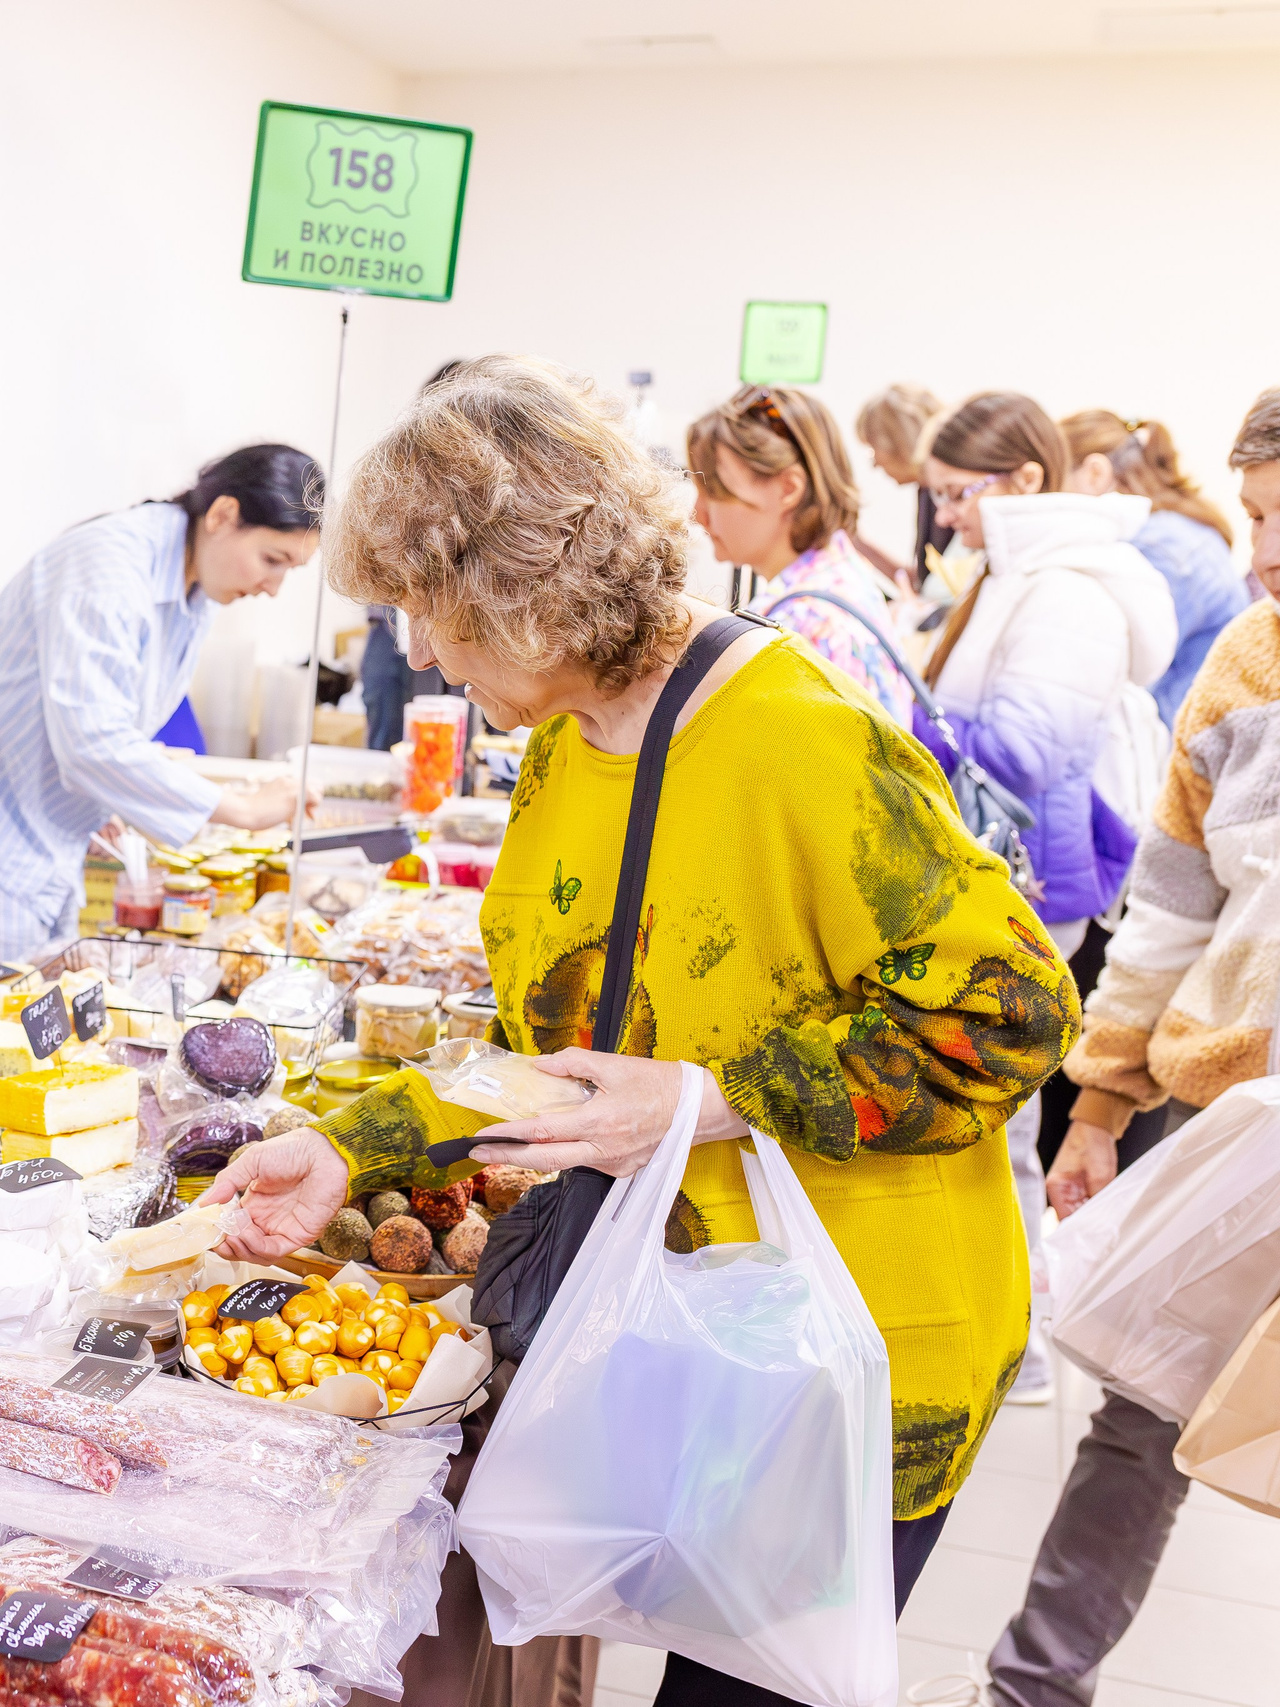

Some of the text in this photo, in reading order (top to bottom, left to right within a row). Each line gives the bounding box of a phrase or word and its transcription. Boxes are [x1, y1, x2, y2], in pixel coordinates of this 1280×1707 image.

[329, 147, 394, 193] 158
[300, 221, 406, 252] ВКУСНО
[273, 249, 424, 284] И ПОЛЕЗНО
